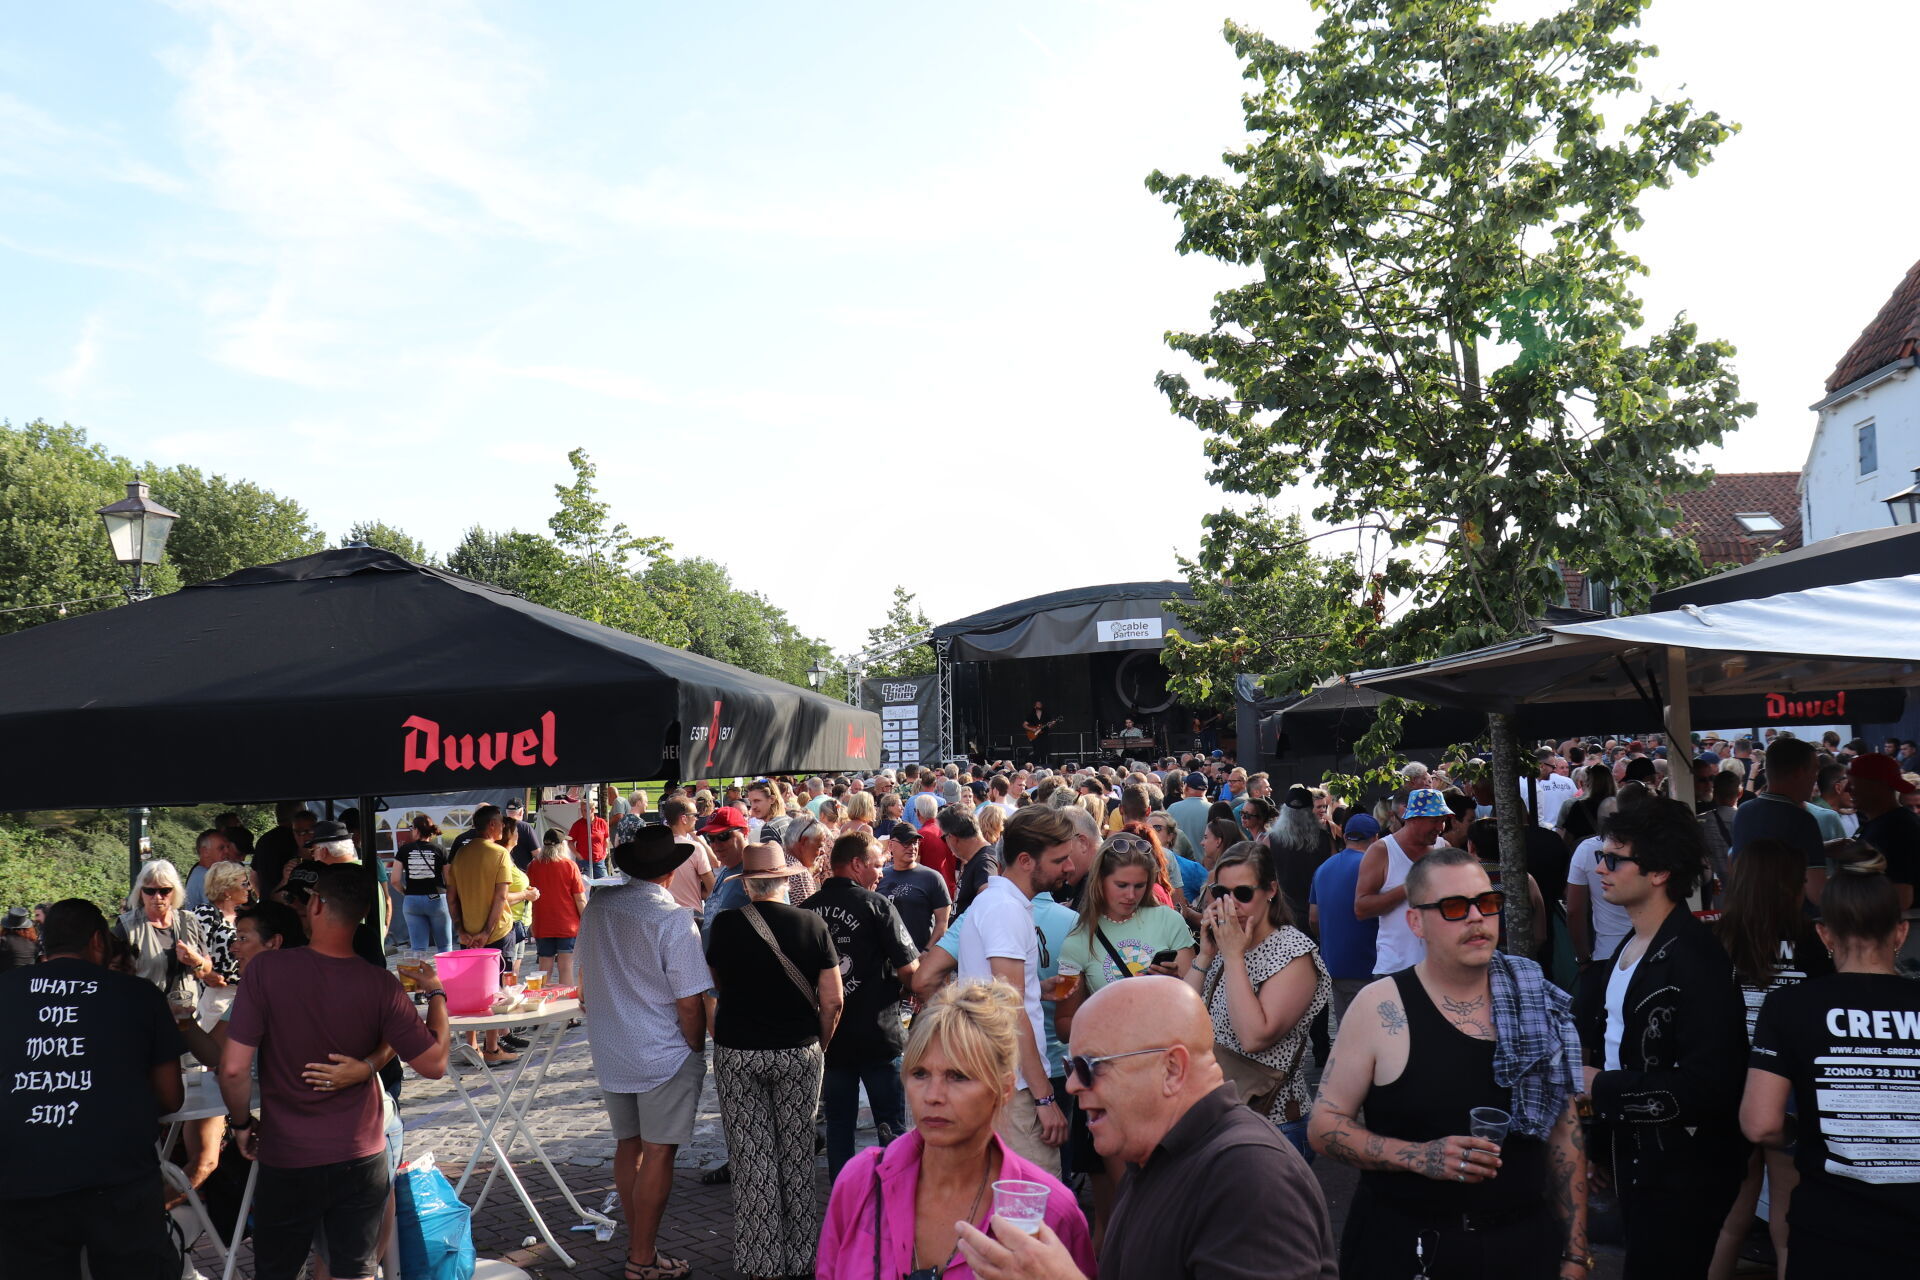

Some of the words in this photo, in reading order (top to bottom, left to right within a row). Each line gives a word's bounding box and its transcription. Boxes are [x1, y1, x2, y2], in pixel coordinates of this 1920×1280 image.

[1113, 629, 1149, 640] partners
[1122, 622, 1149, 631] cable
[885, 691, 916, 702] Blues
[1765, 691, 1845, 718] Duvel
[401, 710, 559, 773] Duvel
[832, 907, 860, 931] CASH
[30, 978, 98, 997] WHAT'S
[38, 1005, 79, 1027] ONE
[1826, 1007, 1920, 1040] CREW
[26, 1036, 86, 1062] MORE
[11, 1070, 92, 1093] DEADLY
[1823, 1067, 1873, 1077] ZONDAG
[1875, 1068, 1890, 1077] 28
[1893, 1069, 1916, 1078] JULI
[25, 1100, 80, 1128] SIN?
